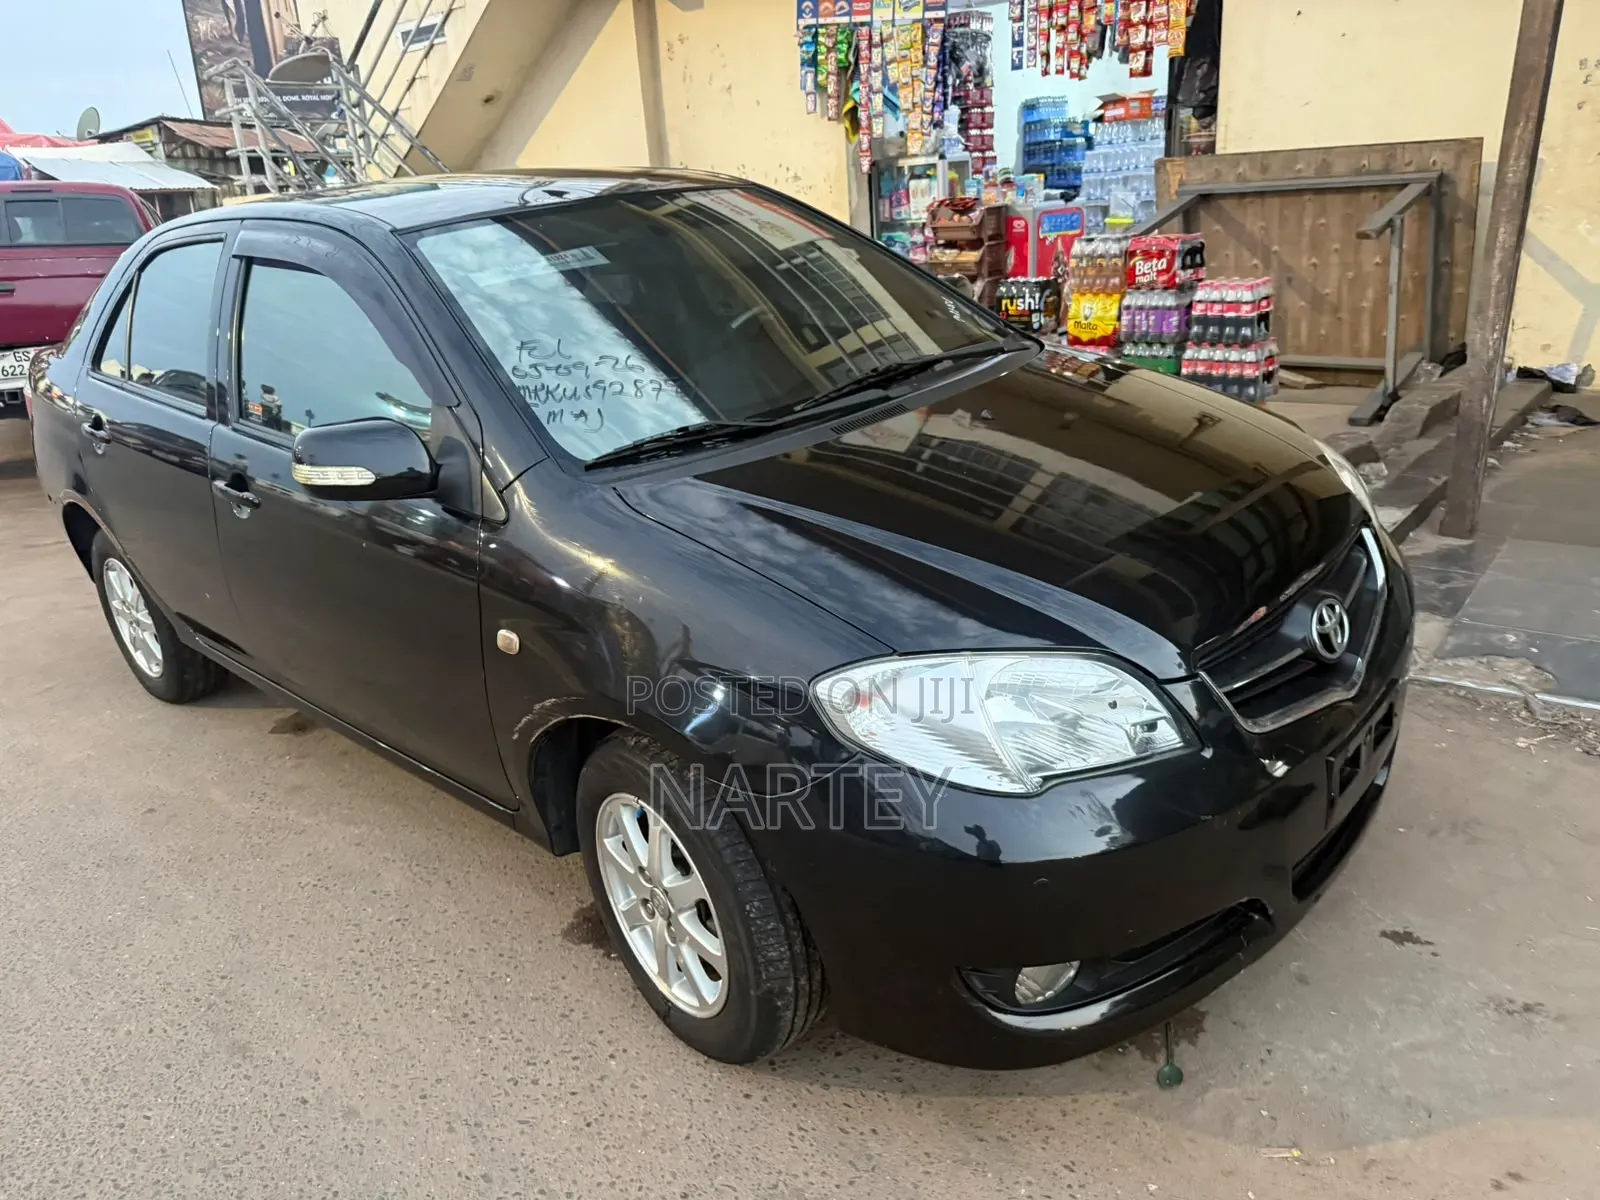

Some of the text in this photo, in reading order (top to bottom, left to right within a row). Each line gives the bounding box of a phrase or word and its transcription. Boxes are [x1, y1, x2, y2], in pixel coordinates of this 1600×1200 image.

[1135, 257, 1168, 276] Beta
[1135, 271, 1158, 285] malt
[1001, 290, 1041, 311] rush!
[1073, 320, 1098, 331] Malta
[13, 350, 31, 362] GS
[1, 364, 27, 377] 622
